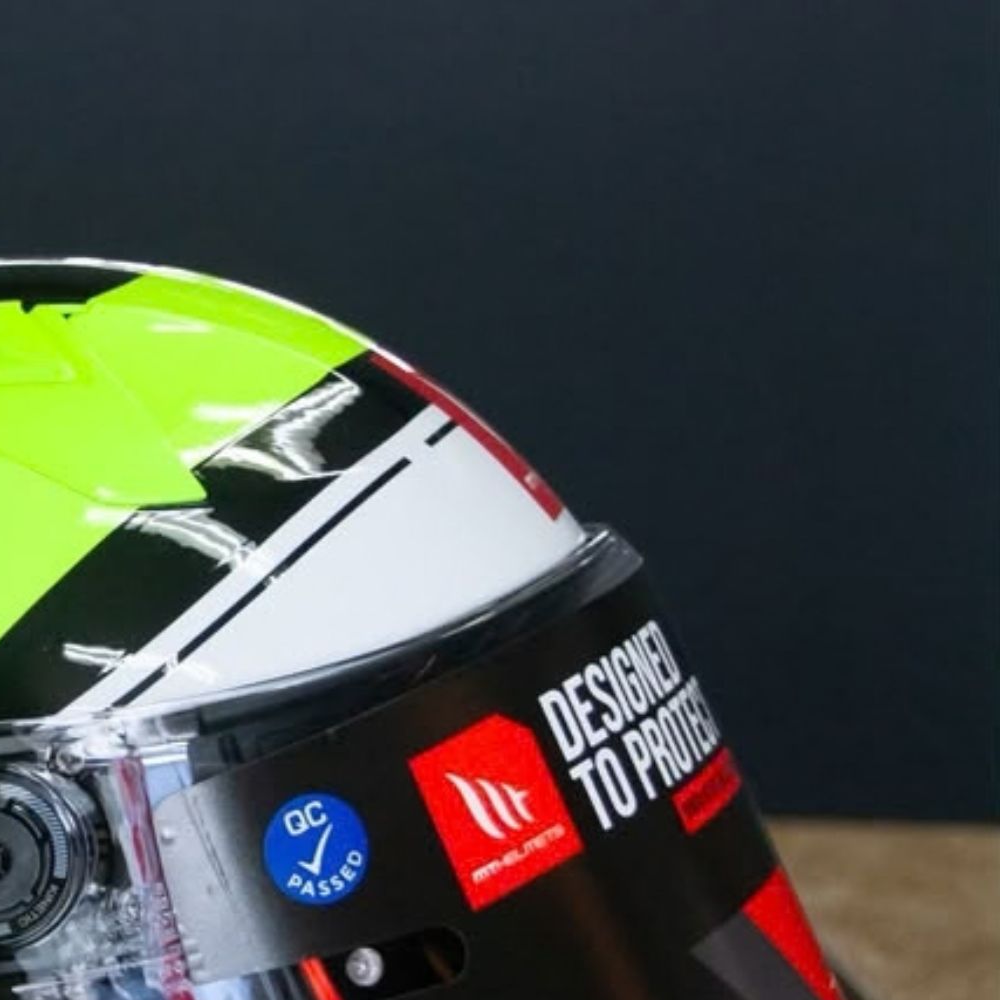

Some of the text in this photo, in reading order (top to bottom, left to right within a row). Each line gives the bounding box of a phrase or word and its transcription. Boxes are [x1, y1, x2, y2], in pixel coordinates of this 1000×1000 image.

[538, 619, 682, 763] DESIGNED
[283, 800, 328, 836] QC
[568, 747, 638, 831] TO
[286, 849, 363, 898] PASSED
